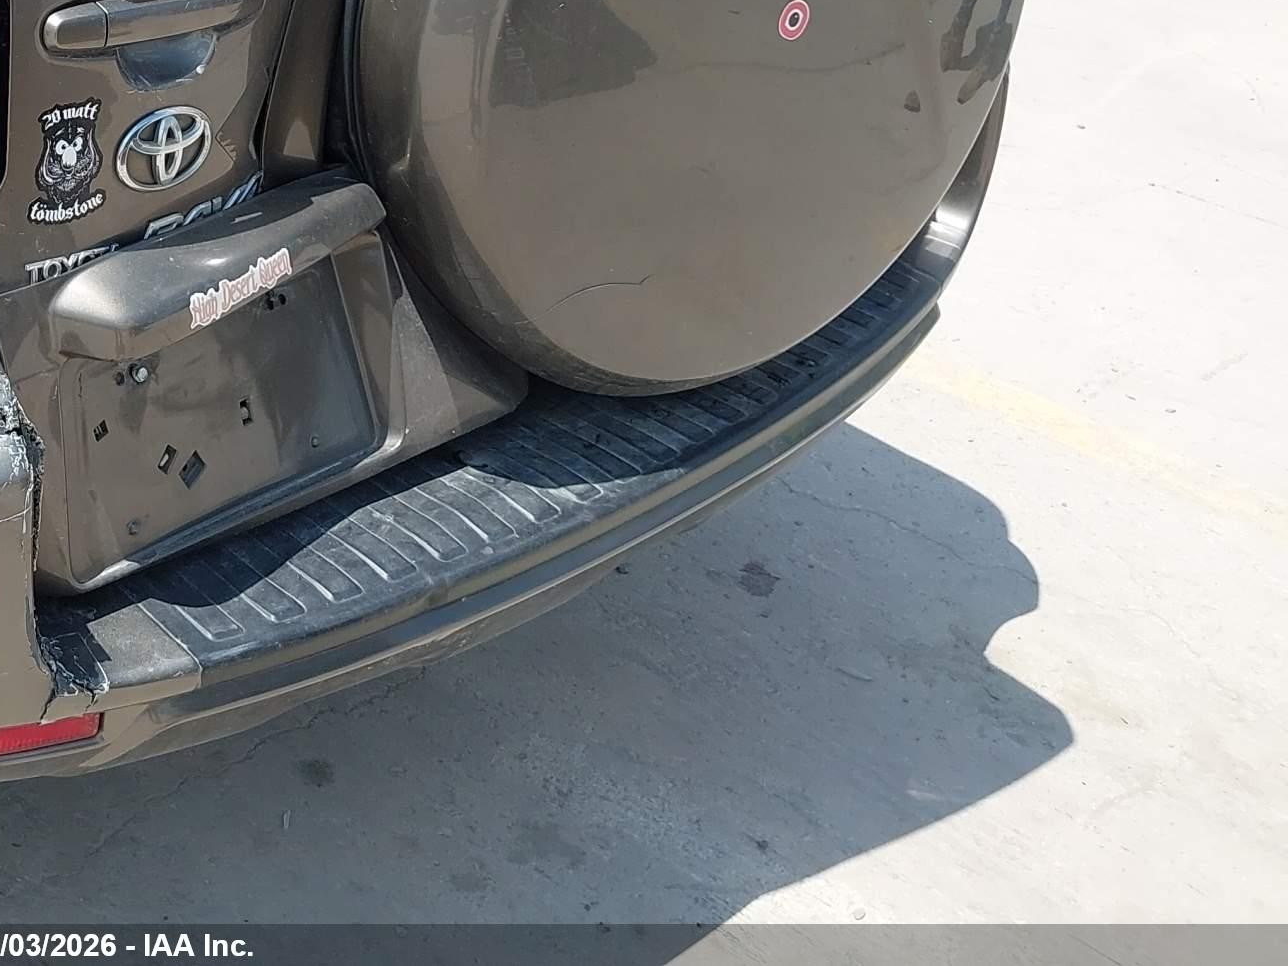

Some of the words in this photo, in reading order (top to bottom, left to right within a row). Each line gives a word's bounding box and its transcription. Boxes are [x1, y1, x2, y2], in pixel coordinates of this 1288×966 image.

[41, 108, 62, 131] 20
[24, 242, 120, 284] TOY
[191, 291, 220, 327] High
[220, 270, 259, 311] Desert
[258, 249, 291, 286] Queen
